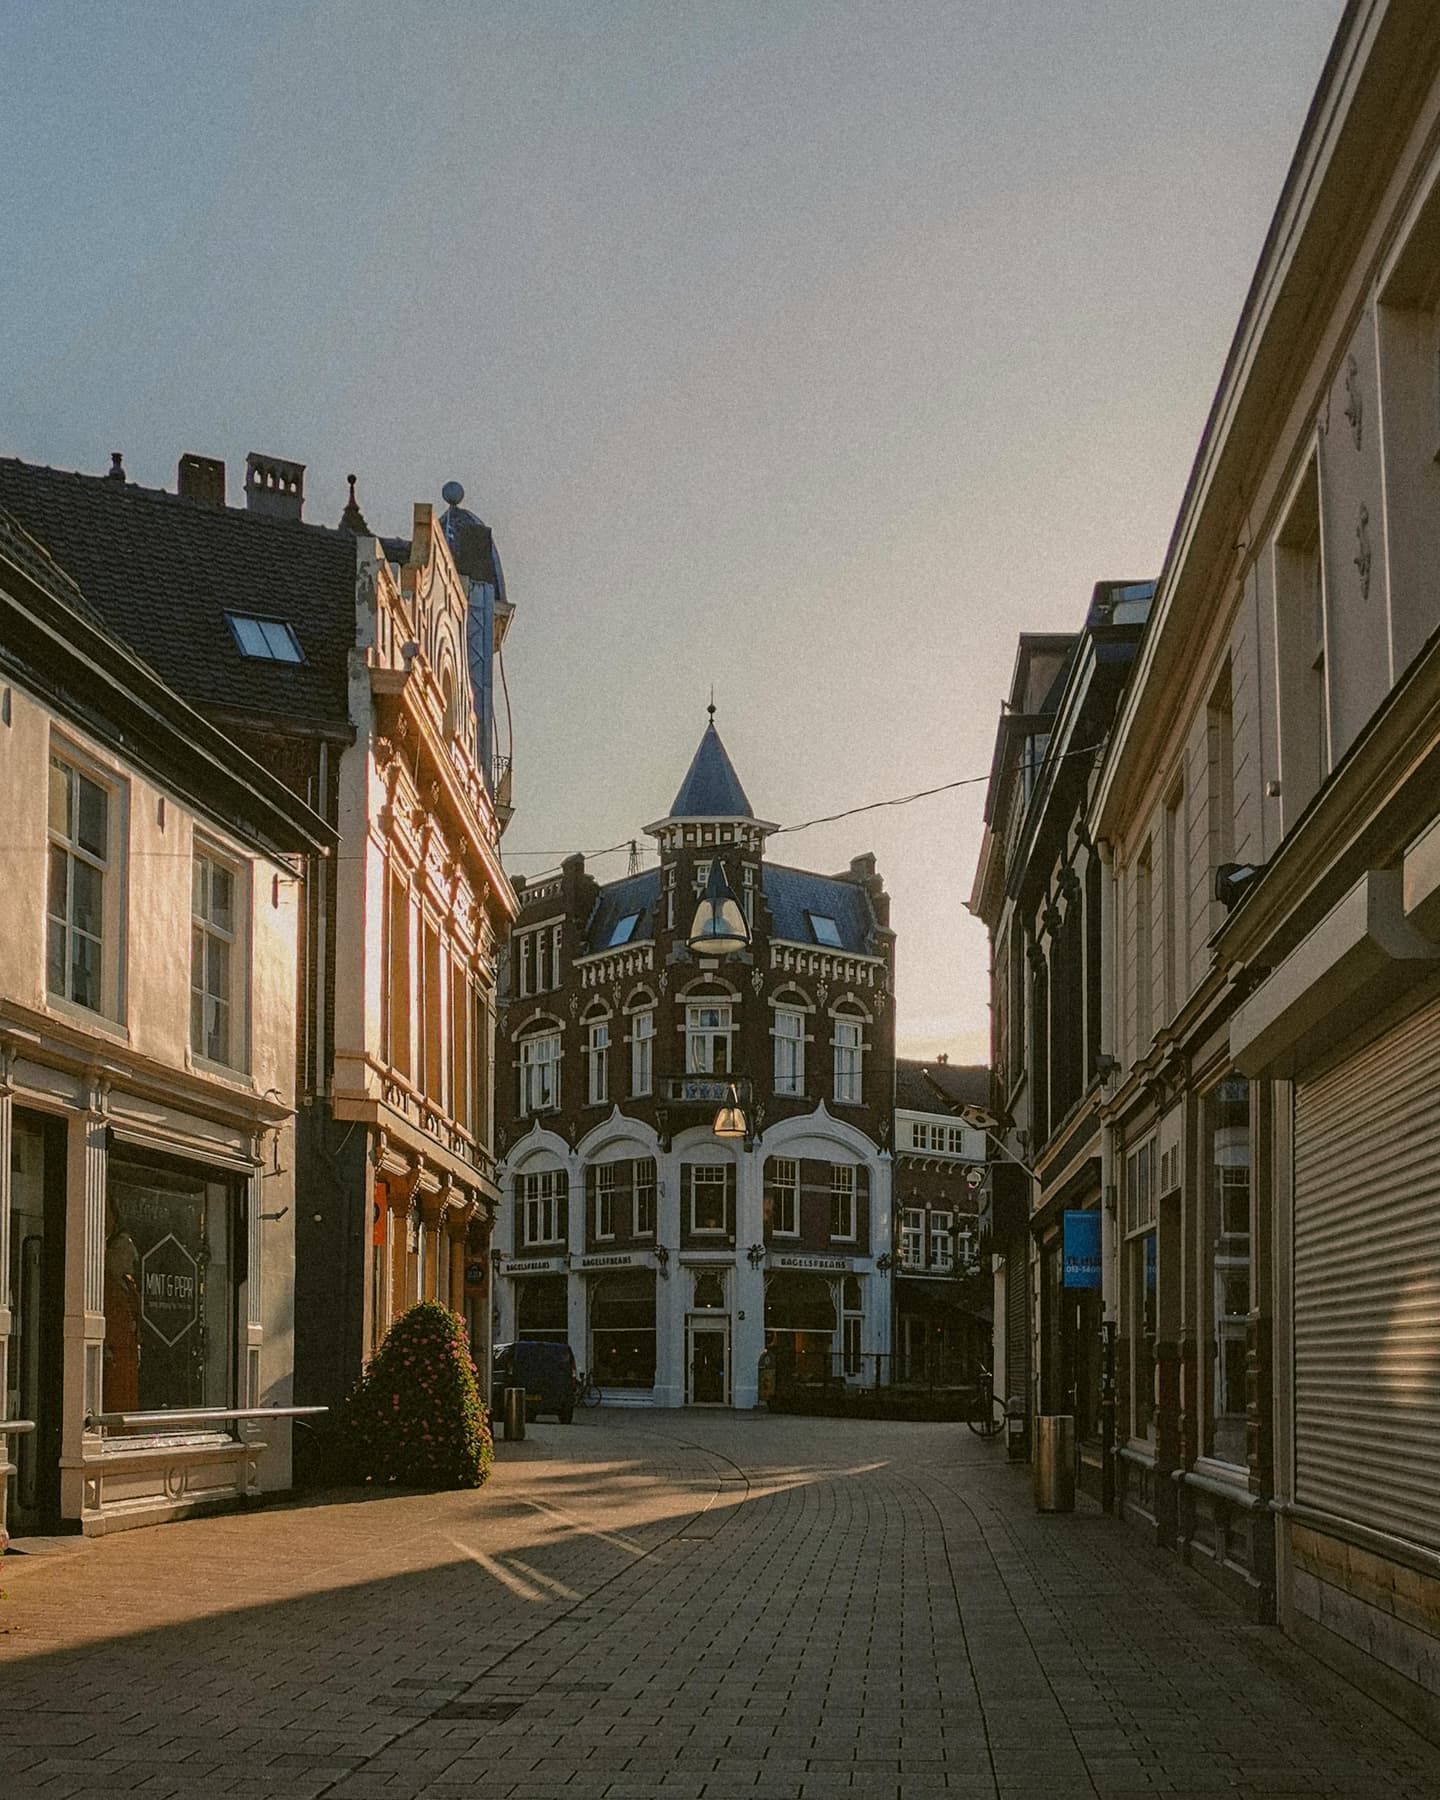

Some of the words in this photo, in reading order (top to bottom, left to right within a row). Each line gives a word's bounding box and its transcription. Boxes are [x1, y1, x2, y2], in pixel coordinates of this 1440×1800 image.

[146, 1273, 166, 1297] MINT
[166, 1275, 174, 1297] &
[174, 1275, 193, 1300] PEPR
[737, 1310, 746, 1321] 2
